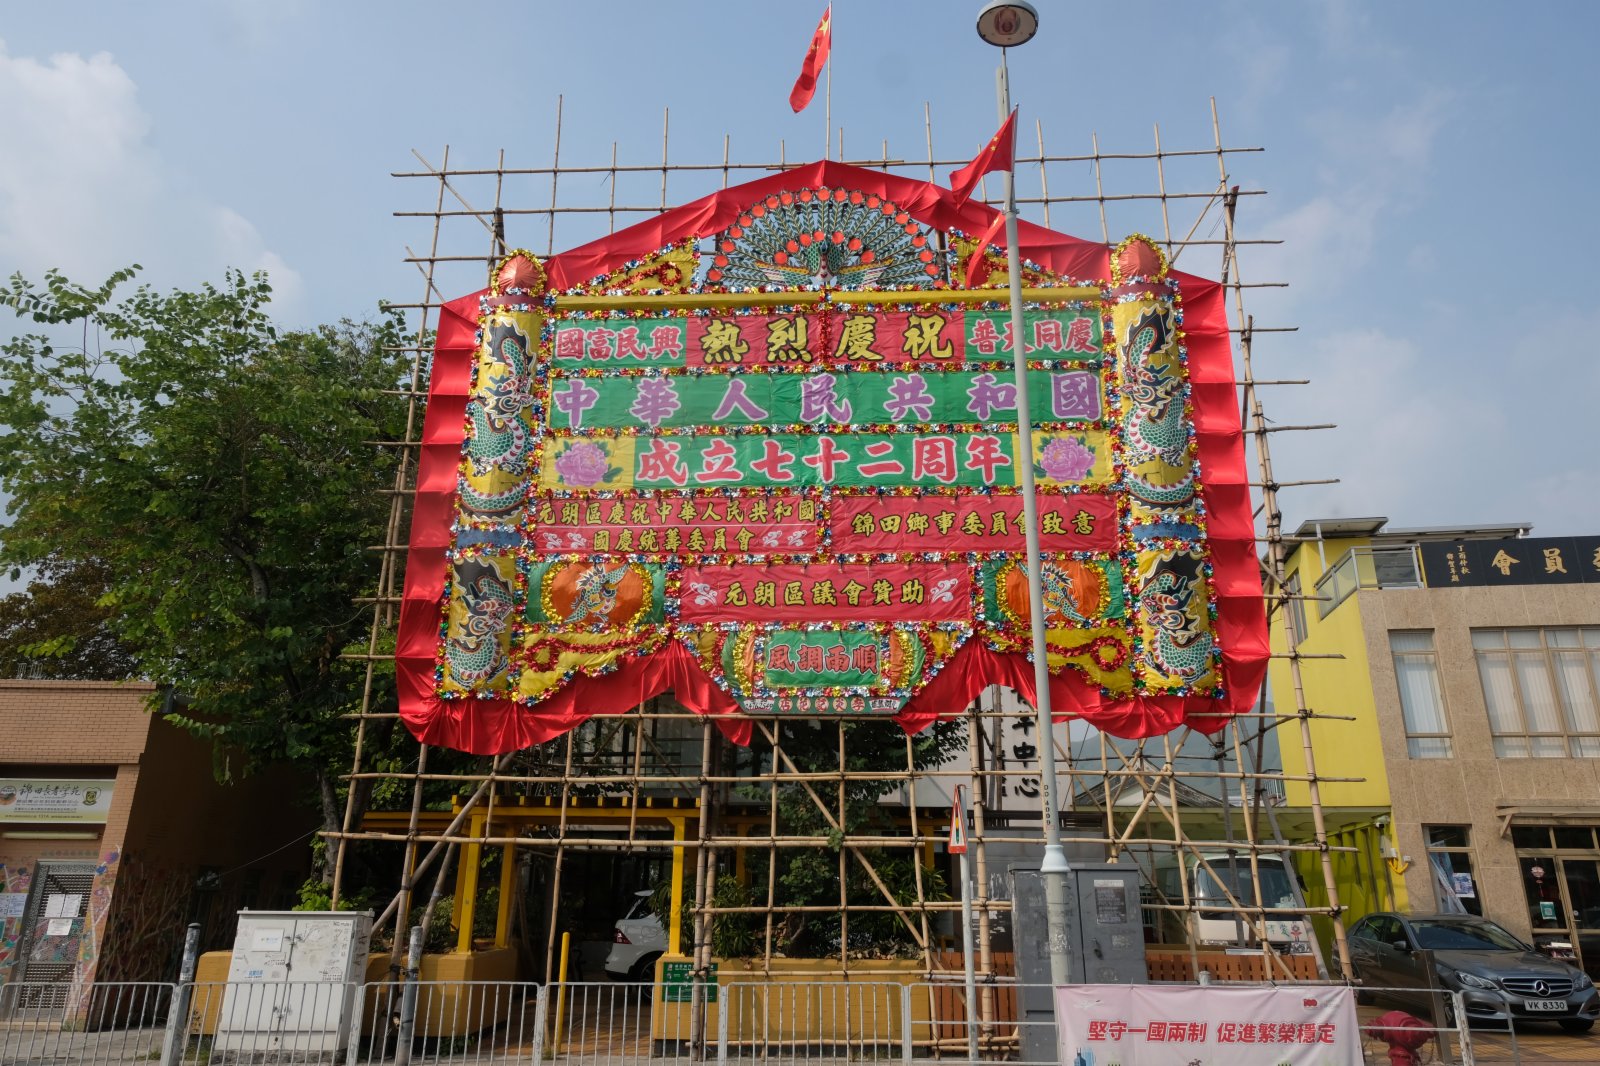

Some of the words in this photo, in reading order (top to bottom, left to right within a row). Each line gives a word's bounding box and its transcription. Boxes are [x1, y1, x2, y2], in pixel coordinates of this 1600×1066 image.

[554, 325, 683, 361] 國富民興
[699, 313, 954, 364] 熱烈慶祝
[553, 371, 1101, 428] 中華人民共和國
[635, 435, 1011, 486] 成立七十二周年
[537, 500, 816, 525] 元朗區慶祝中華人民共和國
[592, 527, 756, 552] 國慶統籌委員會
[724, 578, 925, 607] 元朗區議會贊助
[767, 644, 879, 674] 風調雨順
[1527, 1002, 1541, 1010] VK
[1542, 1002, 1565, 1010] 8330
[1087, 1020, 1208, 1043] 堅守一國兩制
[1216, 1021, 1336, 1044] 促進繁榮穩定
